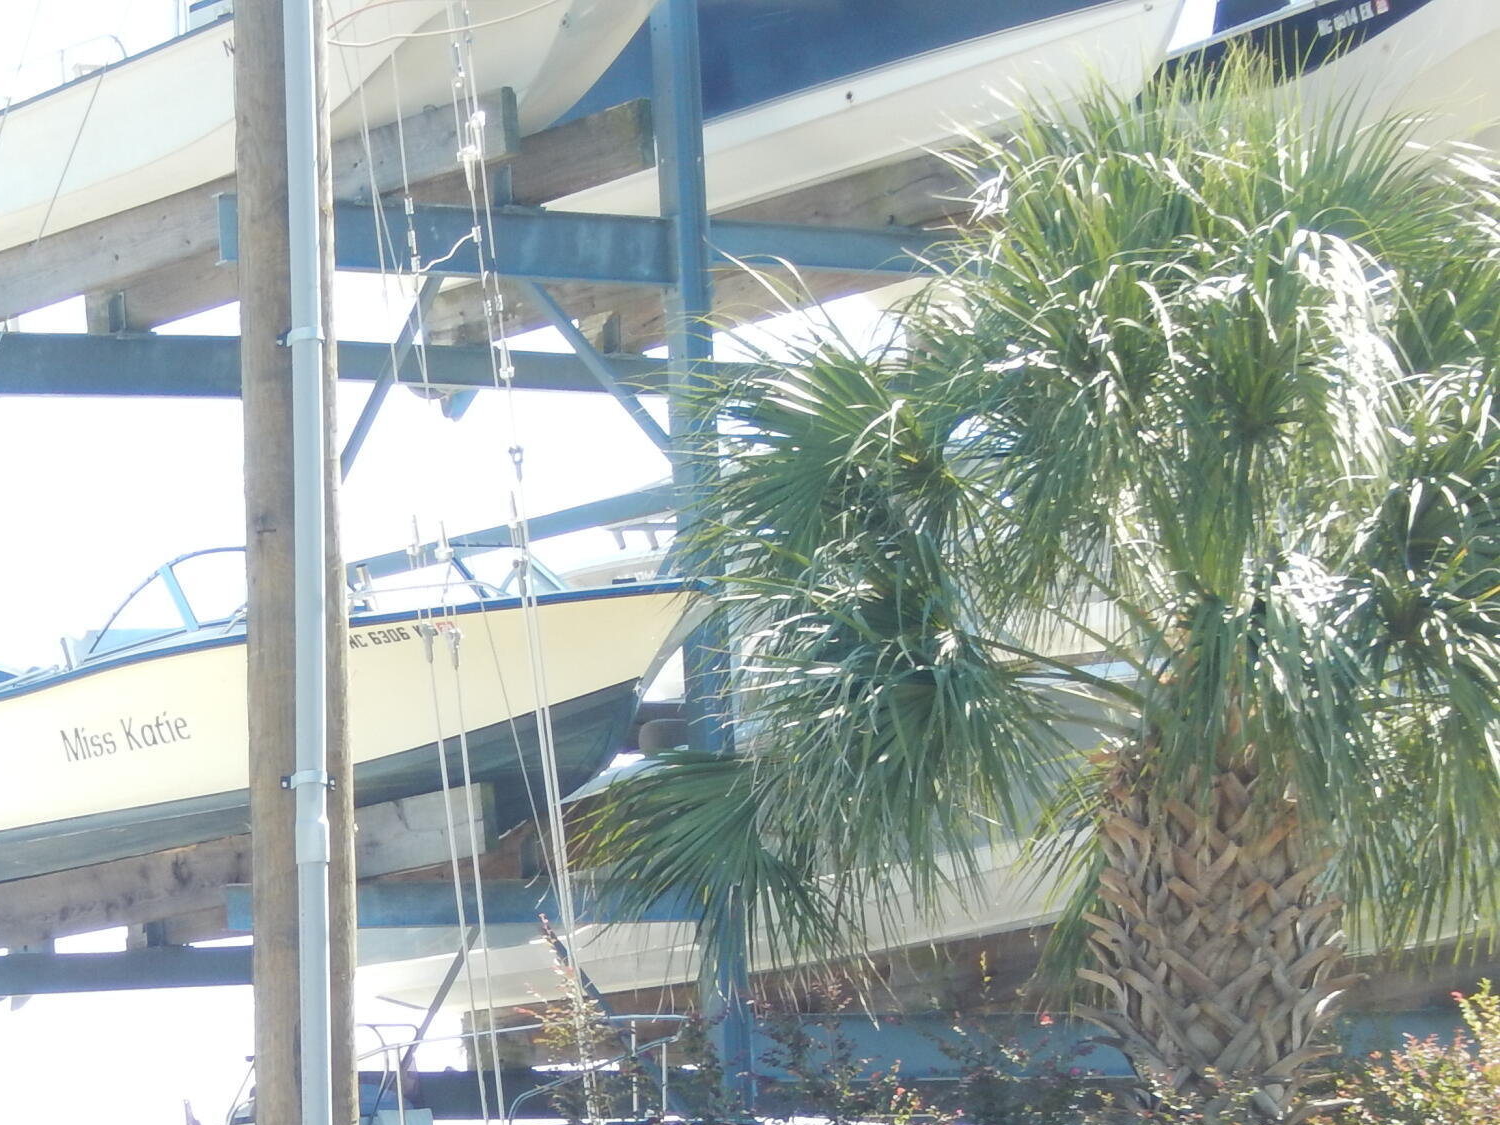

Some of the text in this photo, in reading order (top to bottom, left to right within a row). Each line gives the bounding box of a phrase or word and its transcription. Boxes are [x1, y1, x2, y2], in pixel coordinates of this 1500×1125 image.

[368, 626, 411, 646] 6306
[60, 711, 192, 763] Miss Katie
